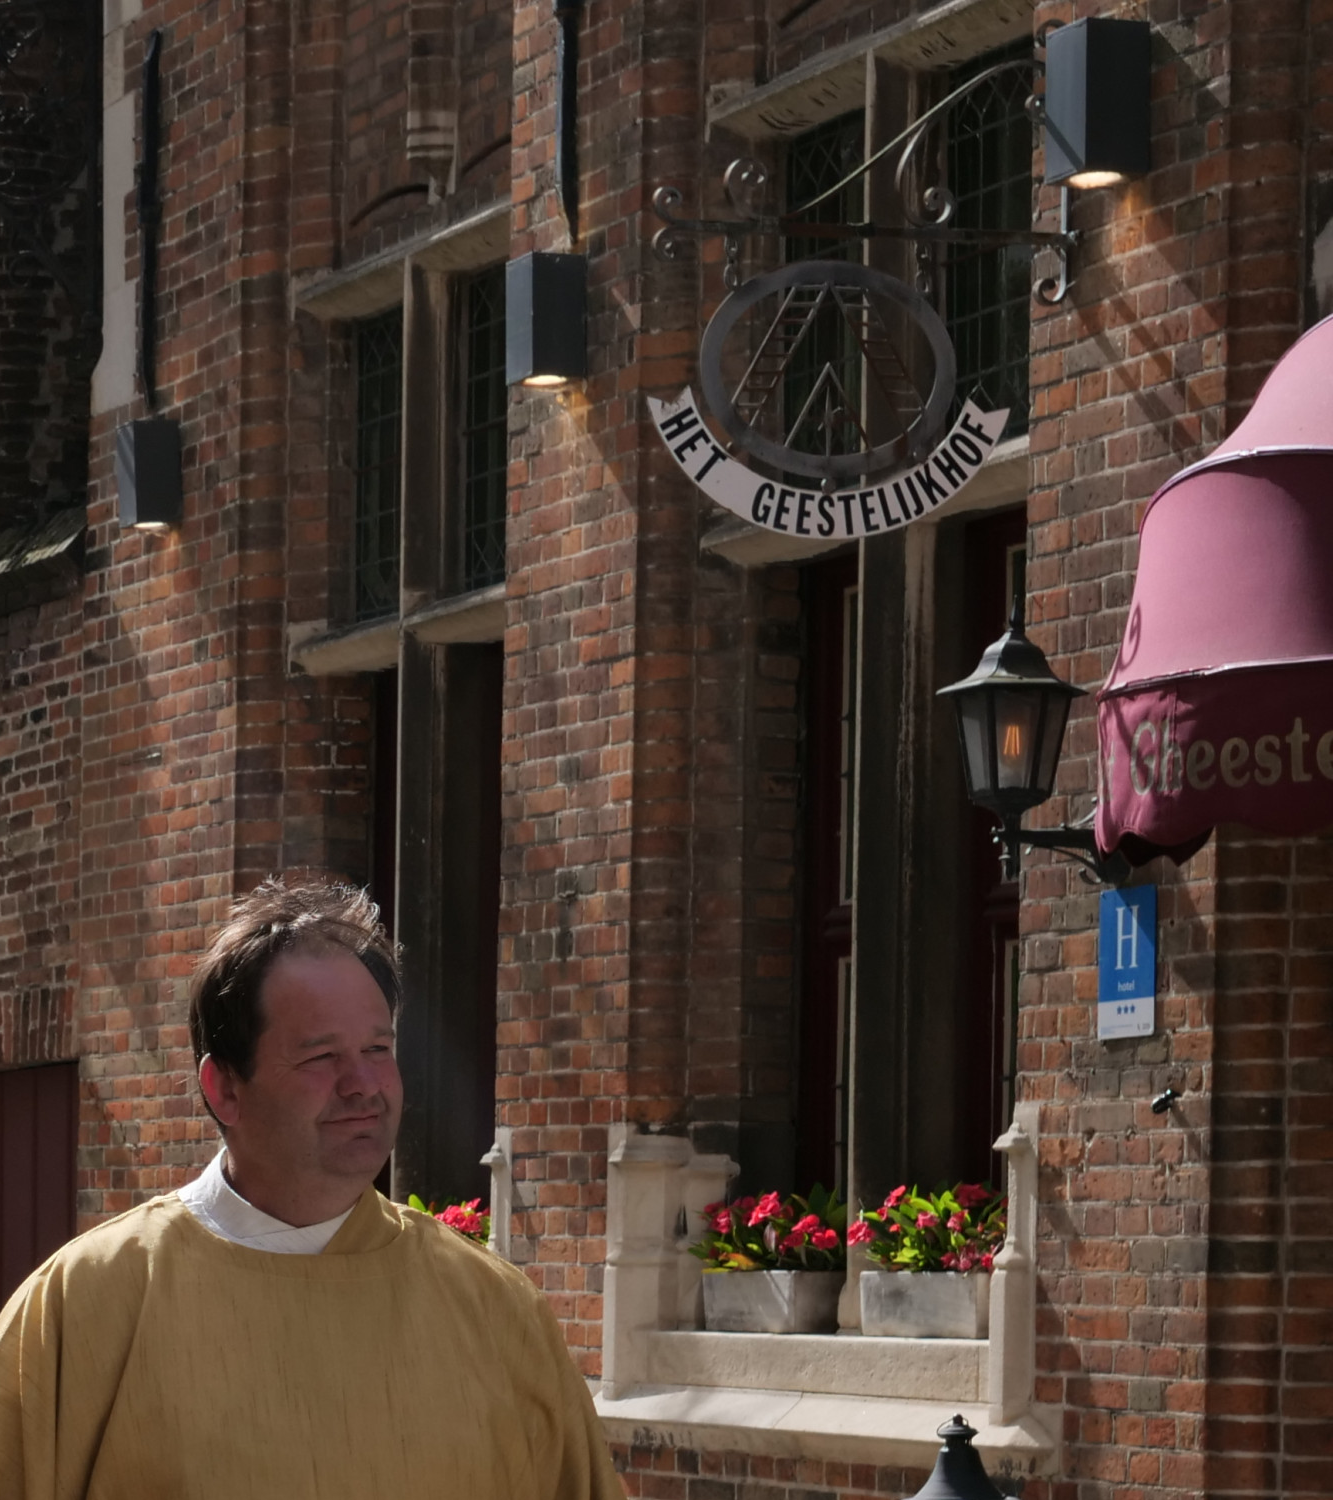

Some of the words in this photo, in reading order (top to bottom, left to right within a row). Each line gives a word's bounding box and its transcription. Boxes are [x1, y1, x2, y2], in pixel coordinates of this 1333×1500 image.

[659, 406, 729, 483] HET
[751, 412, 996, 537] GEESTELIJKHOF
[1114, 904, 1140, 970] H
[1117, 980, 1136, 992] hotel
